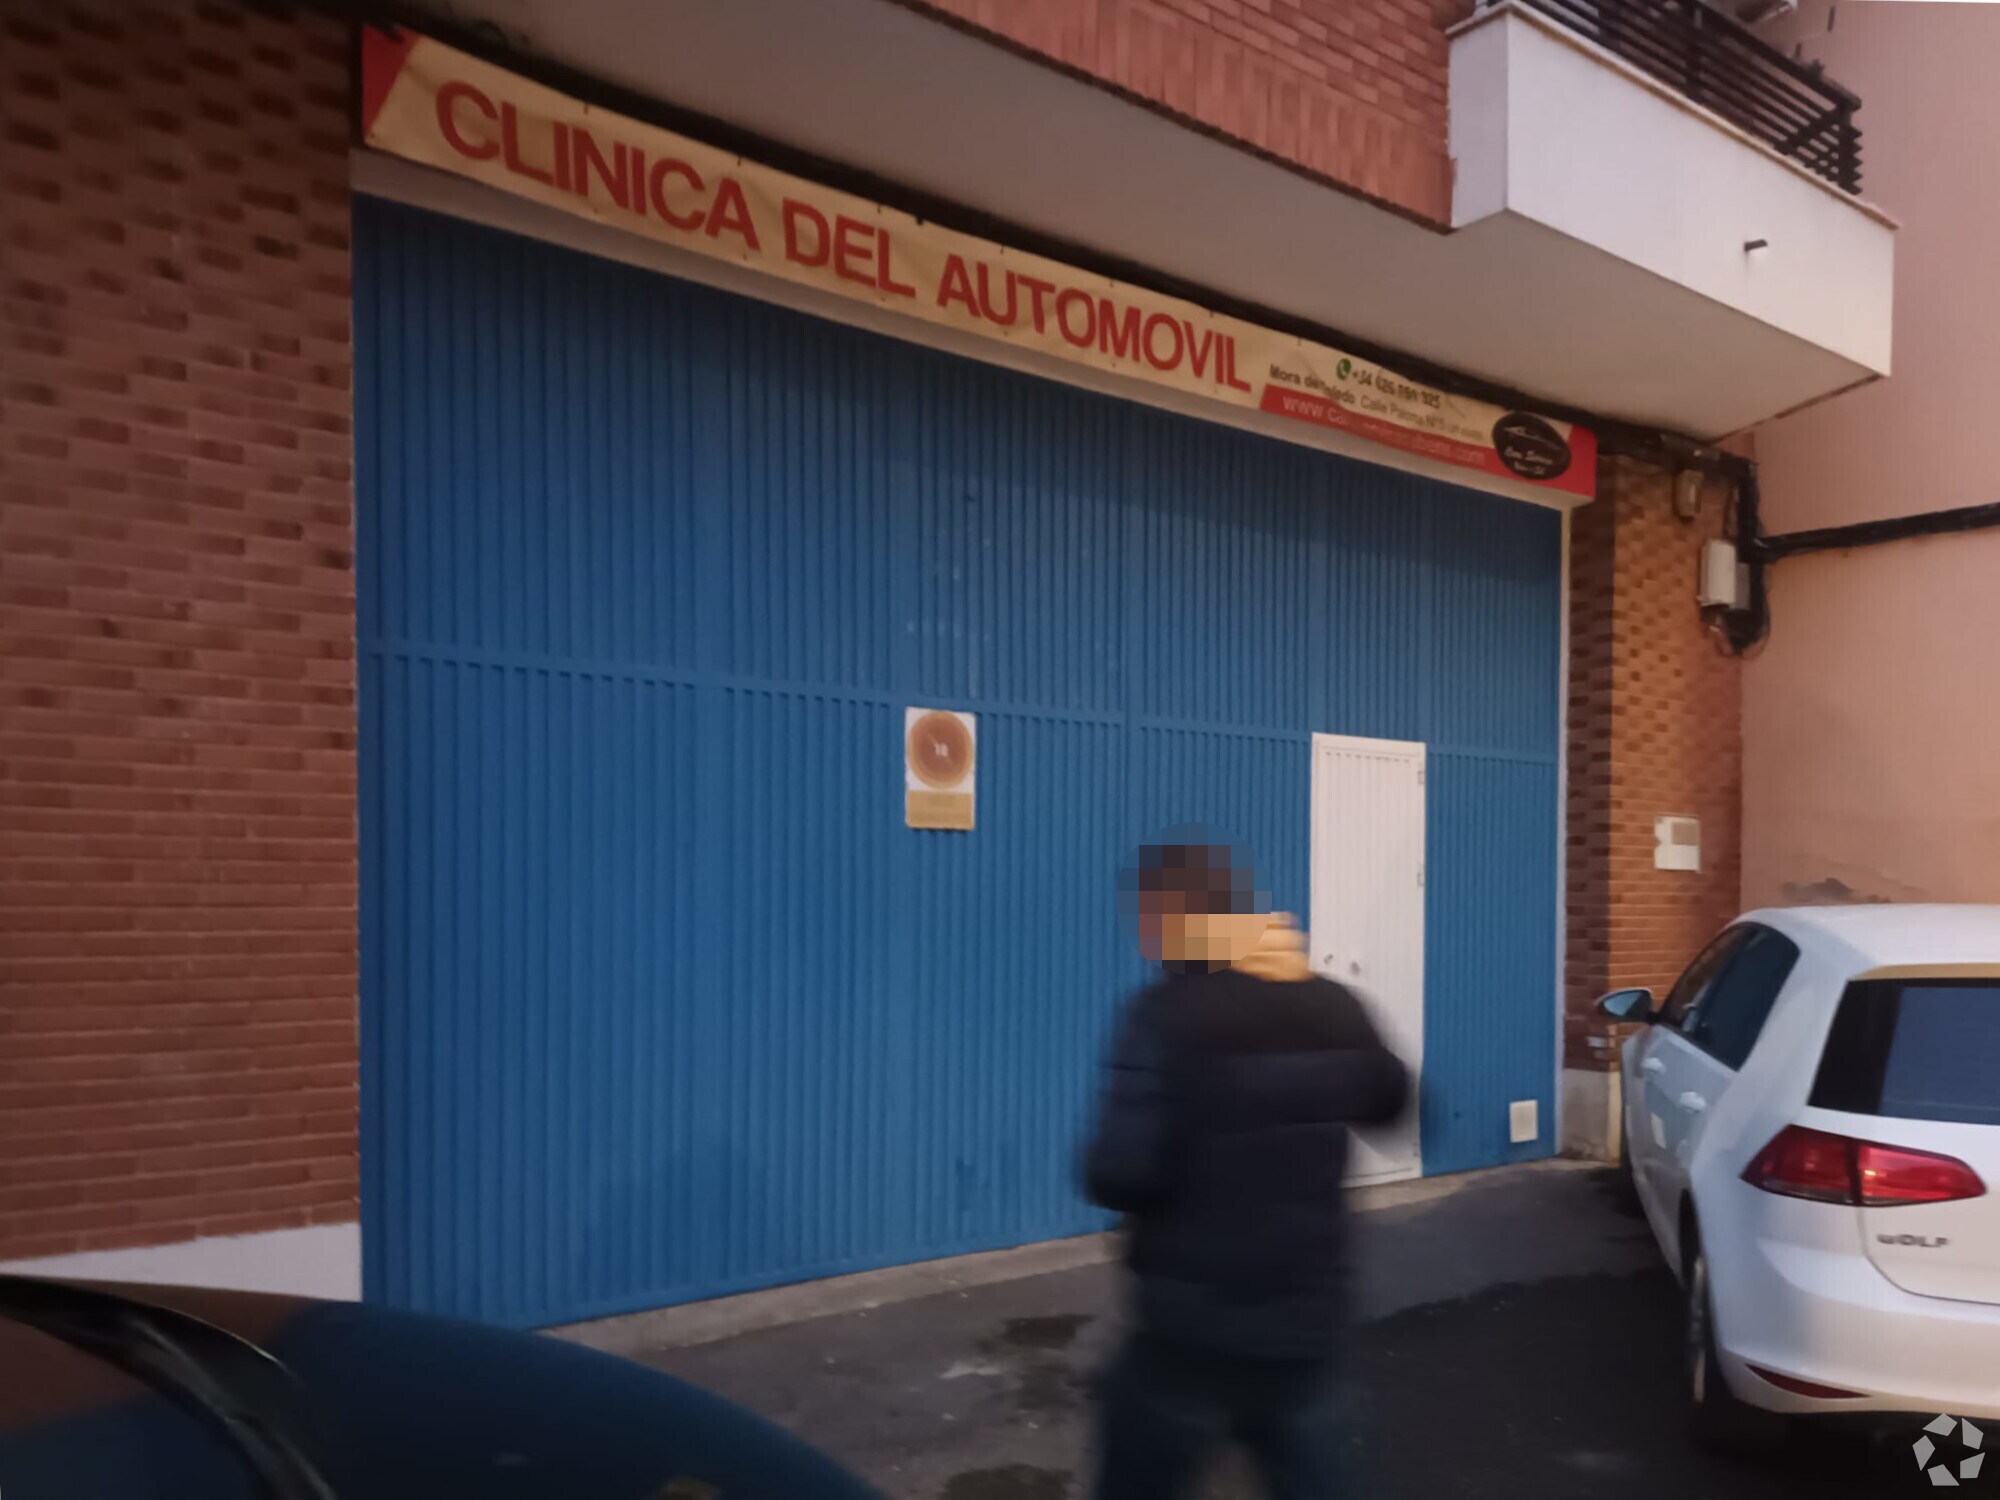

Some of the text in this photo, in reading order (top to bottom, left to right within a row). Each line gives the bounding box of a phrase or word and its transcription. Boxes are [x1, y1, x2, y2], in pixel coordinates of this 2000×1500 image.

[436, 81, 1252, 392] CLINICA DEL AUTOMOVIL
